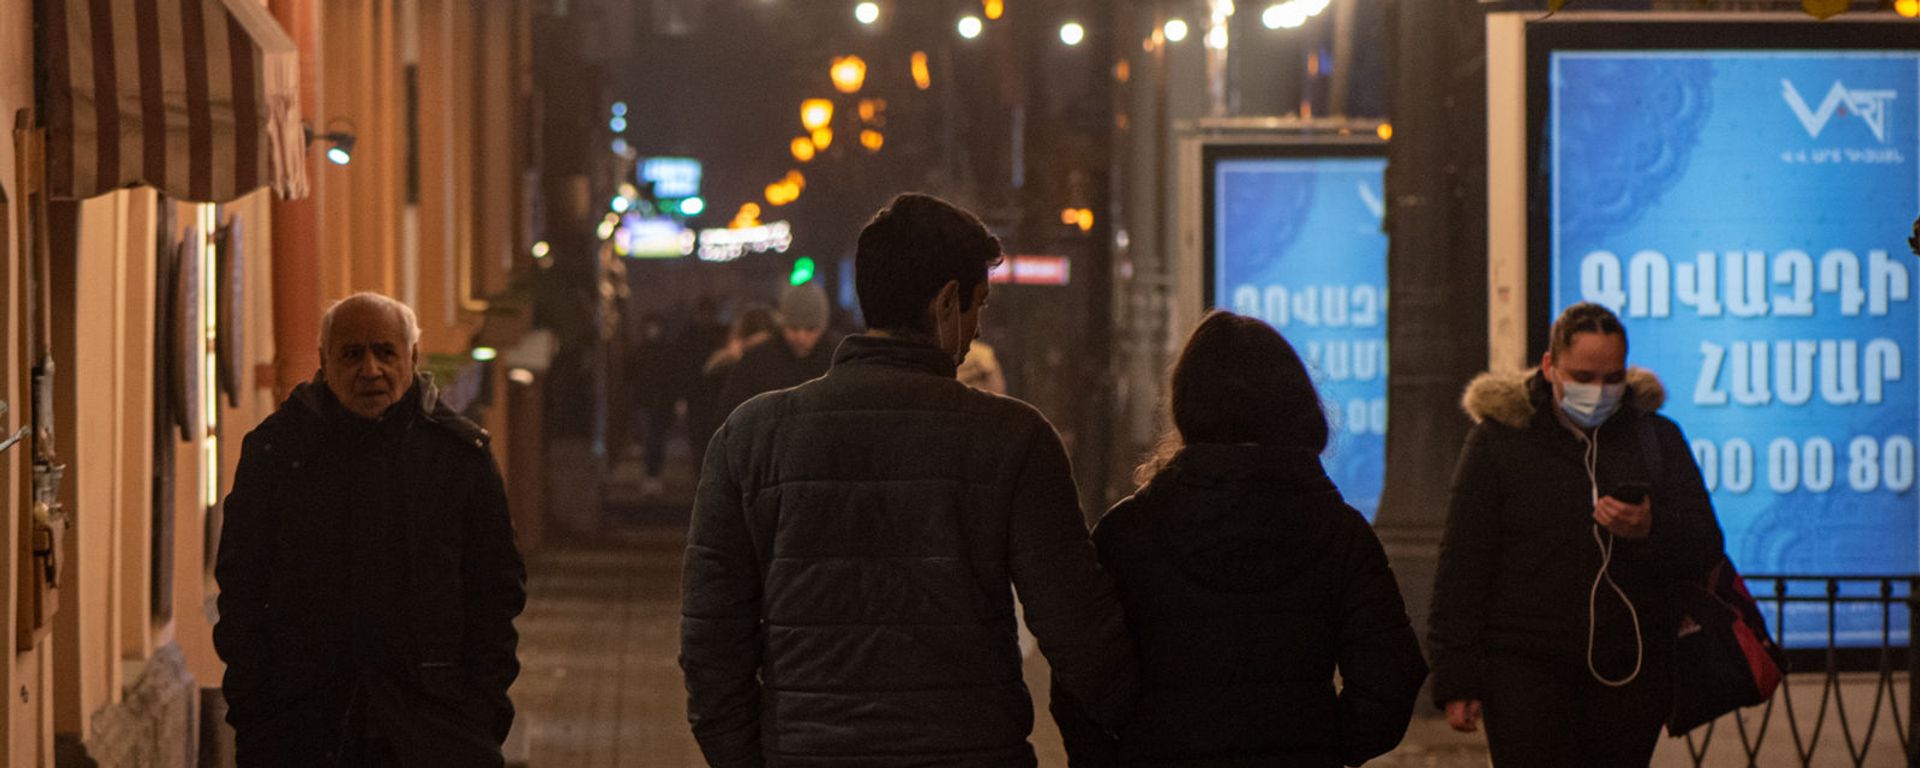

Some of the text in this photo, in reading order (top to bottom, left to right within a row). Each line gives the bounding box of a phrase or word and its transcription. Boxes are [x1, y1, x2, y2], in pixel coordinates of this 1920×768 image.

[1580, 250, 1909, 318] ԳՈՎԱԶԴԻ
[1693, 338, 1901, 406] ՀԱՄԱՐ
[1767, 436, 1835, 494] 00
[1849, 434, 1915, 493] 80
